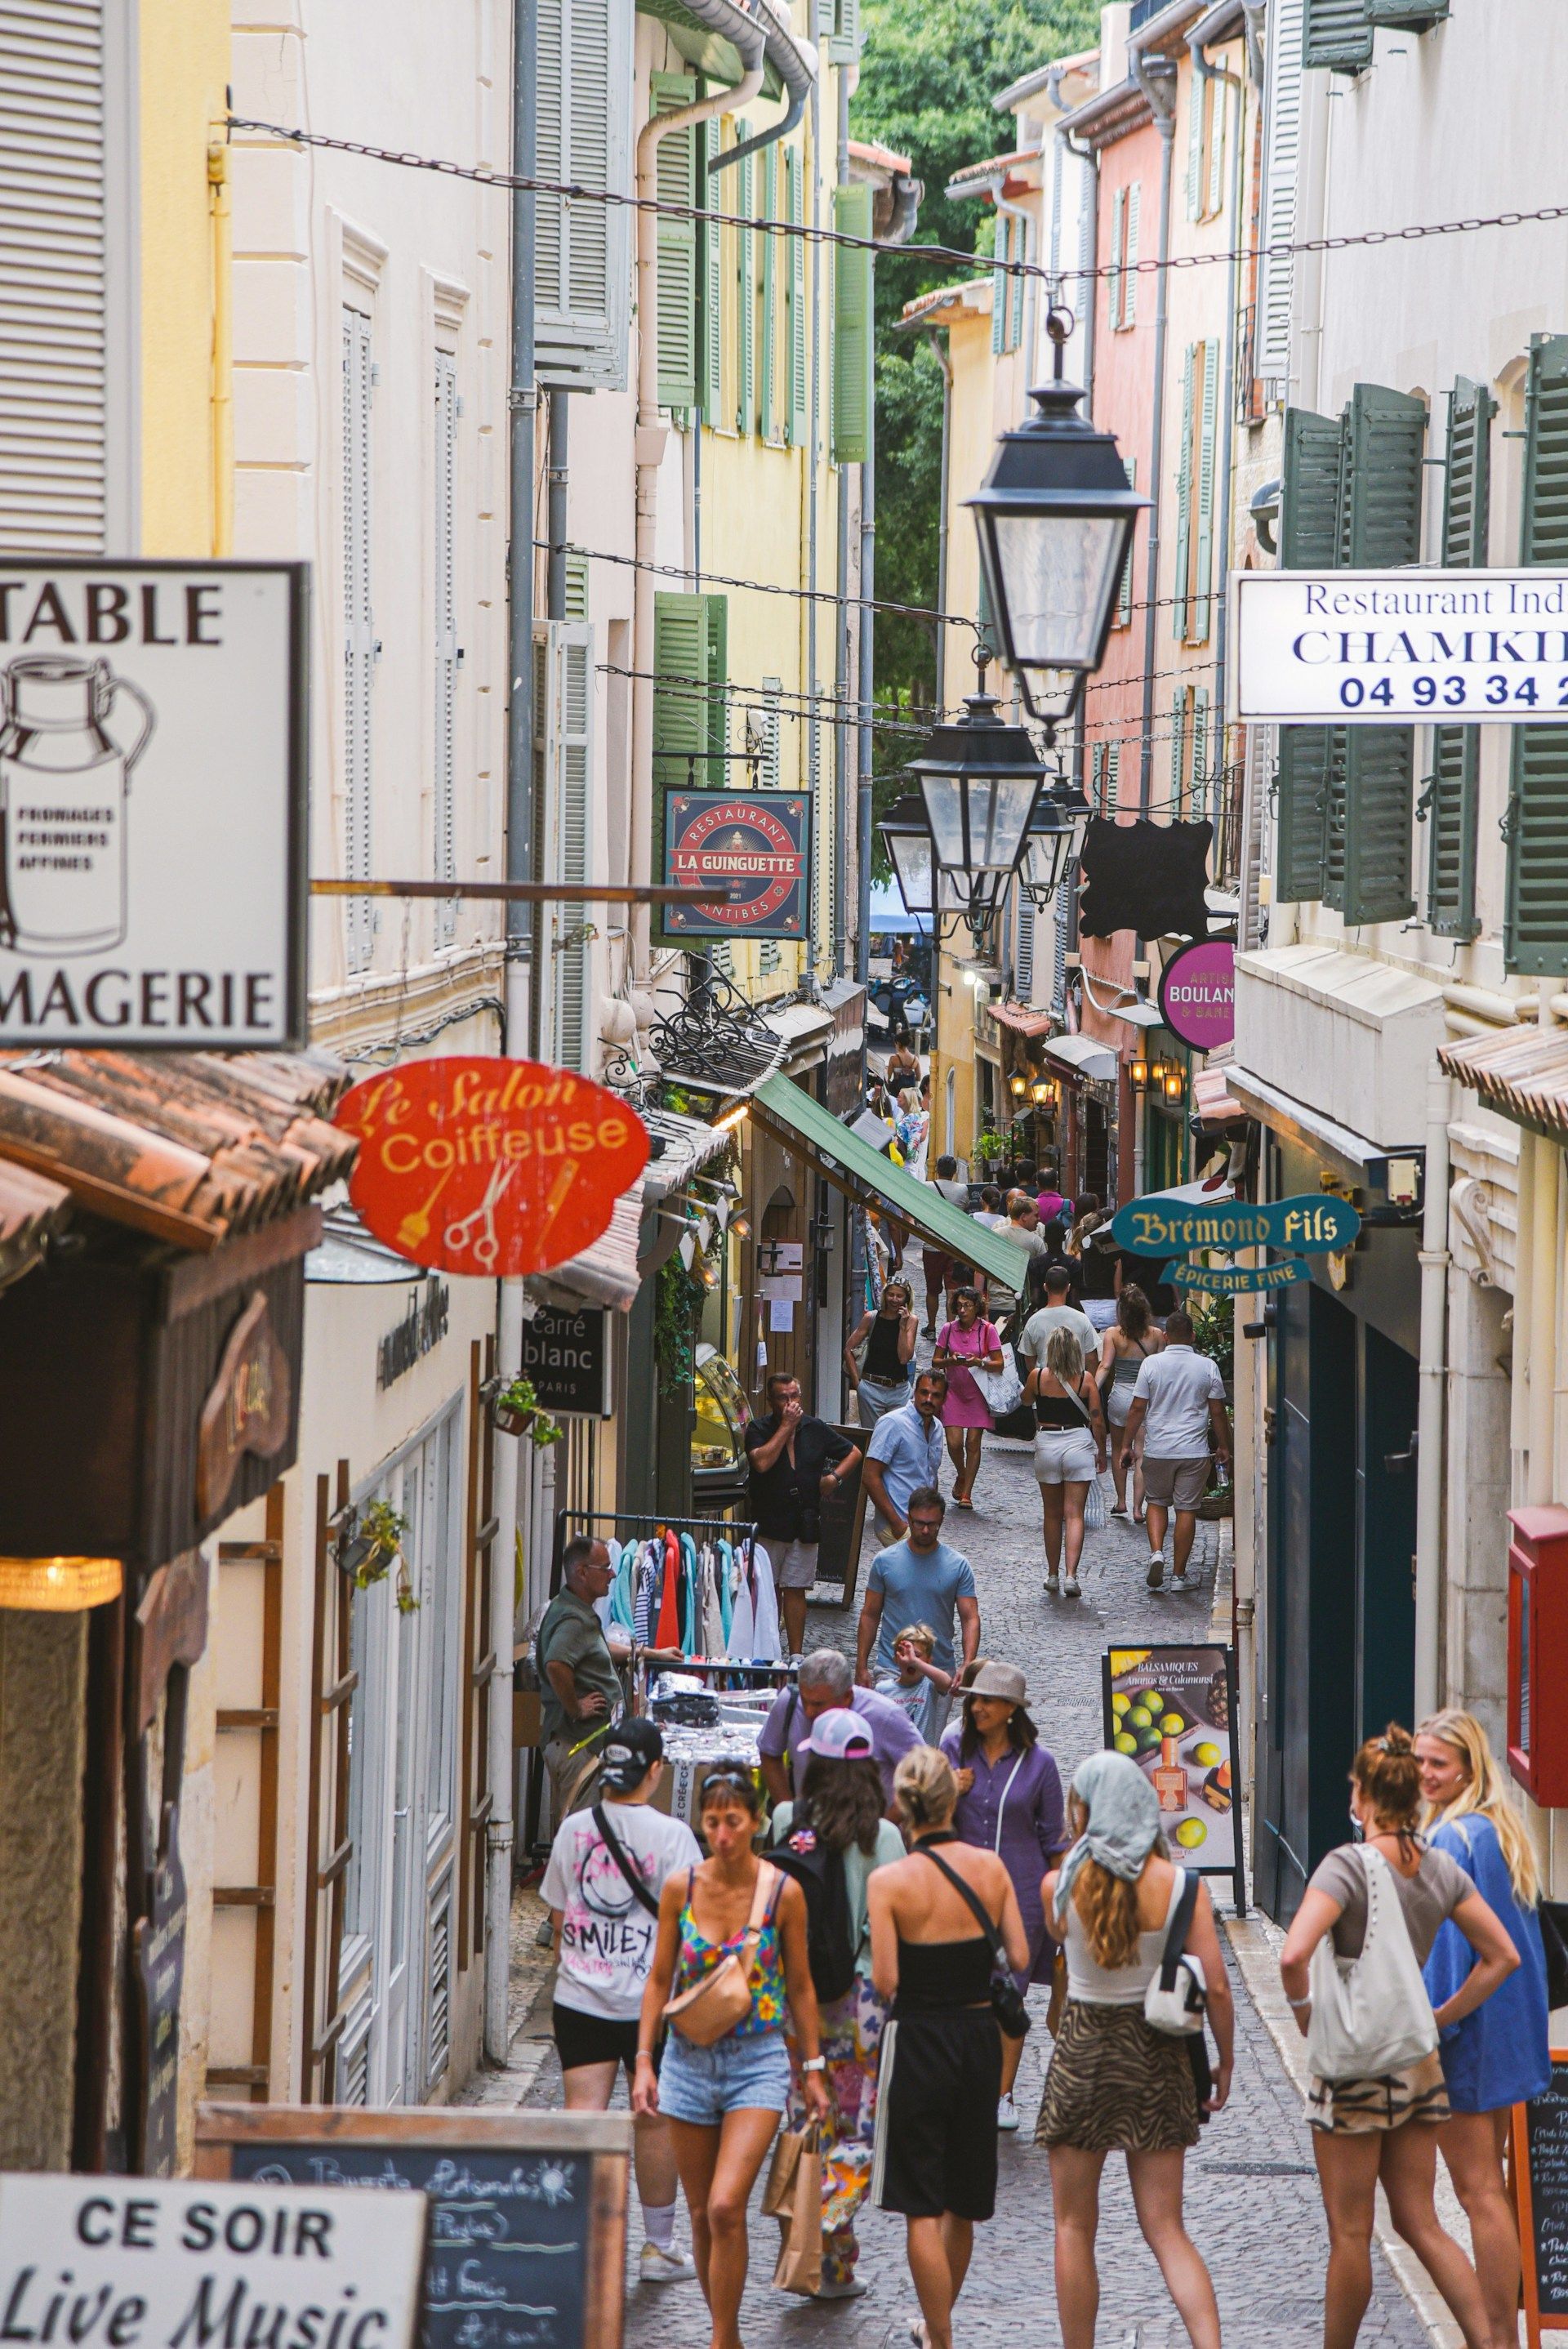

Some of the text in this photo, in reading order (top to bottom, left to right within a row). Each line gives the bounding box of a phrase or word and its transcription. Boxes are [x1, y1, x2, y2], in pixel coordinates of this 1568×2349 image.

[1304, 583, 1568, 615] Restaurant Ind
[1340, 677, 1394, 708] 04
[1413, 675, 1467, 706] 93
[1485, 675, 1539, 706] 34
[689, 808, 786, 843] RESTAURANT
[677, 855, 795, 872] LA GUINGUETTE
[700, 901, 768, 919] ANTIBES
[1169, 986, 1234, 1003] BOULAN
[428, 1067, 577, 1120] Salon
[381, 1118, 627, 1173] Coiffeuse
[1283, 1206, 1338, 1242] Fils
[1174, 1264, 1297, 1290] ÉPICERIE FINE
[524, 1339, 593, 1369] blanc
[539, 1380, 577, 1394] PARIS
[1126, 1674, 1214, 1686] Ananas & Calamansi
[1138, 1662, 1199, 1673] BALSAMIQUES
[77, 2197, 333, 2258] CE SOIR
[0, 2265, 147, 2347] Live
[168, 2273, 388, 2349] Music
